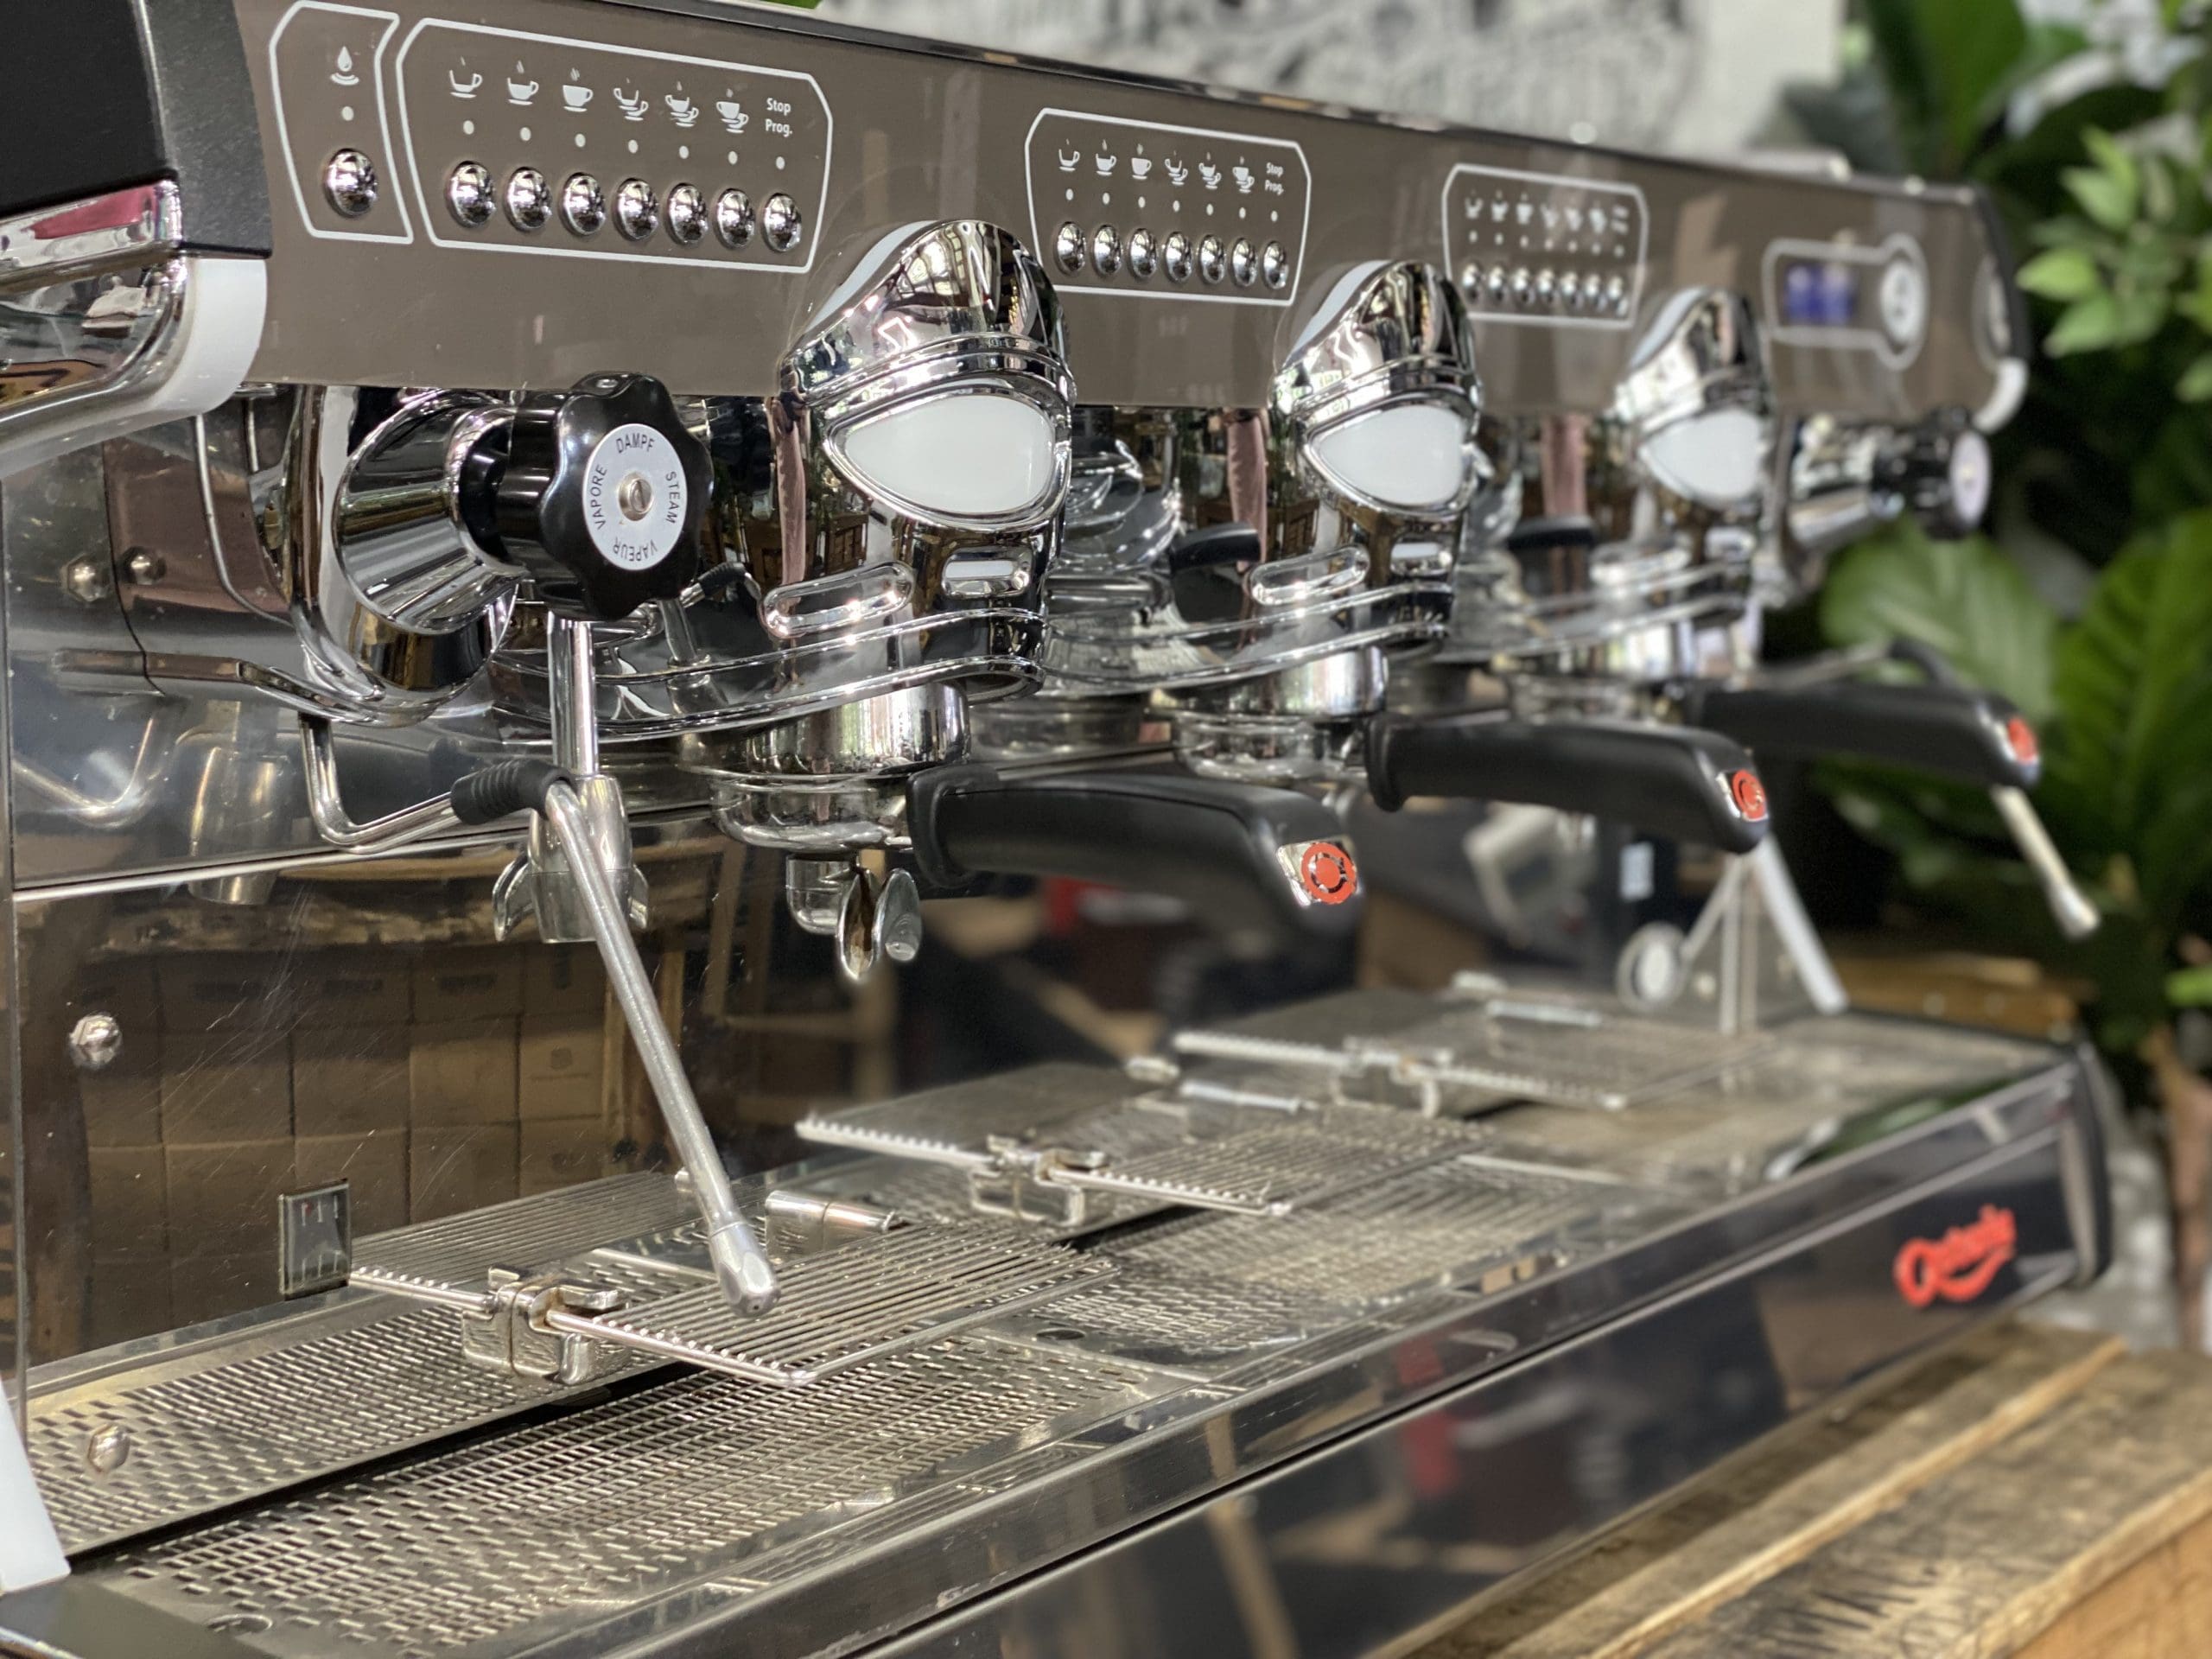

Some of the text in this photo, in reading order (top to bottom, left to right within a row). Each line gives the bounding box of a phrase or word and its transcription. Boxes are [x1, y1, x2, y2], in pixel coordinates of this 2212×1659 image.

[766, 97, 791, 116] Stop
[765, 118, 793, 137] Prog.
[1266, 162, 1283, 177] Stop
[616, 433, 654, 454] DAMPF
[590, 465, 607, 530] VAPORE
[665, 471, 680, 524] STEAM
[613, 537, 658, 562] VAPEUR
